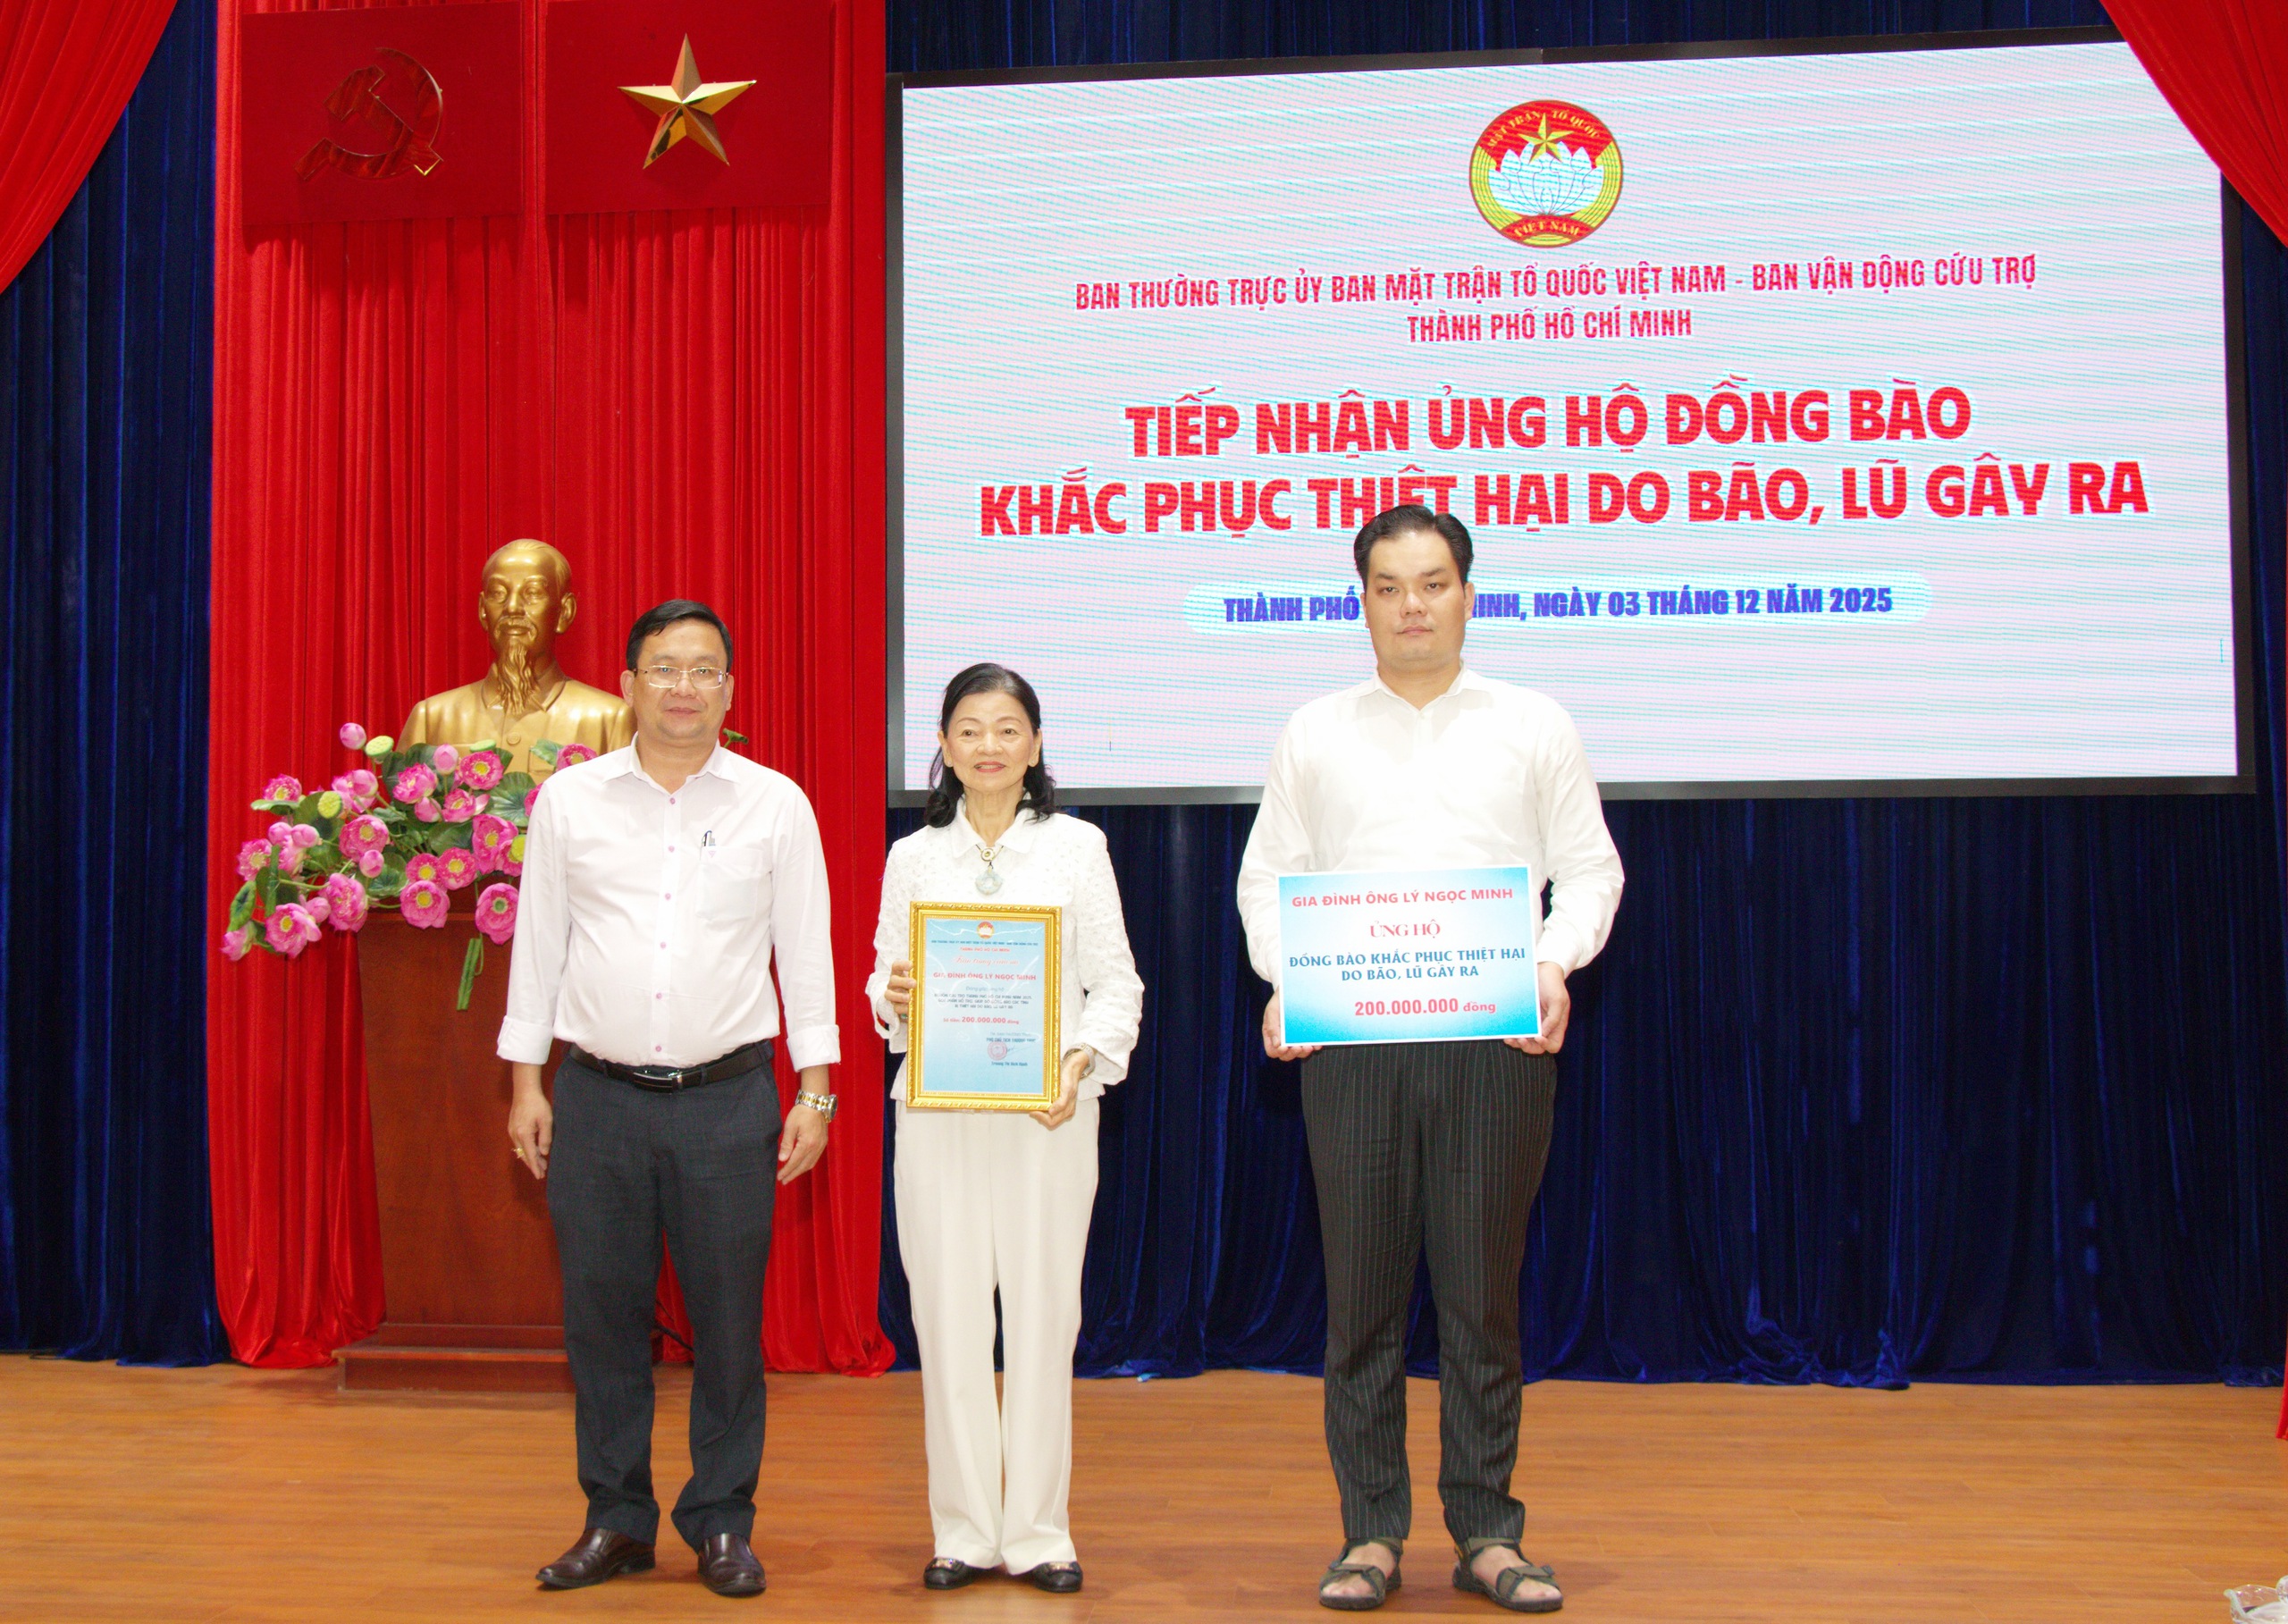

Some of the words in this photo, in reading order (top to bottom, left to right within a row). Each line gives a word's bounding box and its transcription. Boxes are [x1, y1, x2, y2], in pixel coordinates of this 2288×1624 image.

[1076, 282, 1120, 310] BAN
[1129, 273, 1219, 308] THƯỜNG
[1228, 275, 1287, 311] TRỰC
[1295, 267, 1323, 304] ỦY
[1332, 275, 1375, 302] BAN
[1385, 266, 1435, 306] MẶT
[1443, 265, 1501, 304] TRẬN
[1510, 261, 1539, 298] TỔ
[1546, 261, 1606, 299] QUỐC
[1615, 260, 1662, 300] VIỆT
[1672, 265, 1726, 293] NAM
[1753, 263, 1798, 291] BAN
[1807, 255, 1853, 295] VẬN
[1862, 254, 1925, 294] ĐỘNG
[1934, 251, 1983, 286] CỨU
[1992, 253, 2036, 290] TRỢ
[1408, 308, 1482, 342] THÀNH
[1491, 306, 1539, 341] PHỐ
[1544, 304, 1577, 340] HỒ
[1583, 305, 1621, 339] CHÍ
[1630, 309, 1692, 337] MINH
[1125, 386, 1241, 458] TIẾP
[1256, 389, 1409, 459] NHẬN
[1428, 384, 1545, 449] ỦNG
[1566, 383, 1648, 453] HỘ
[1665, 374, 1829, 445] ĐỒNG
[1849, 378, 1971, 442] BÀO
[981, 467, 1126, 536] KHẮC
[1144, 479, 1291, 538] PHỤC
[1475, 473, 1569, 532] HẠI
[1588, 470, 1670, 524] DO
[1688, 461, 1824, 526] BÃO,
[1842, 459, 1907, 519] LŨ
[1925, 452, 2049, 518] GÂY
[2068, 461, 2149, 515] RA
[1224, 592, 1302, 622] THÀNH
[1309, 585, 1359, 620] PHỐ
[1534, 587, 1602, 618] NGÀY
[1609, 590, 1639, 617] 03
[1647, 585, 1729, 615] THÁNG
[1736, 589, 1760, 614] 12
[1767, 584, 1822, 613] NĂM
[1830, 587, 1892, 613] 2025
[1292, 896, 1317, 907] GIA
[1322, 893, 1360, 905] ĐÌNH
[1366, 891, 1399, 904] ÔNG
[1403, 890, 1419, 903] LÝ
[1425, 890, 1467, 904] NGỌC
[1471, 888, 1513, 899] MINH
[1370, 921, 1409, 938] ỦNG
[1414, 919, 1441, 938] HỘ
[1336, 951, 1366, 964] BÀO
[1371, 948, 1410, 964] KHẮC
[1415, 950, 1452, 964] PHỤC
[1457, 947, 1496, 963] THIỆT
[1501, 947, 1526, 961] HẠI
[1342, 970, 1363, 981] DO
[1367, 965, 1401, 980] BÃO,
[1406, 965, 1422, 979] LŨ
[1426, 964, 1455, 978] GÂY
[1459, 966, 1479, 977] RA
[1355, 997, 1459, 1016] 200.000.000
[1463, 1001, 1496, 1014] đồng
[962, 1016, 1006, 1024] 200.000.000
